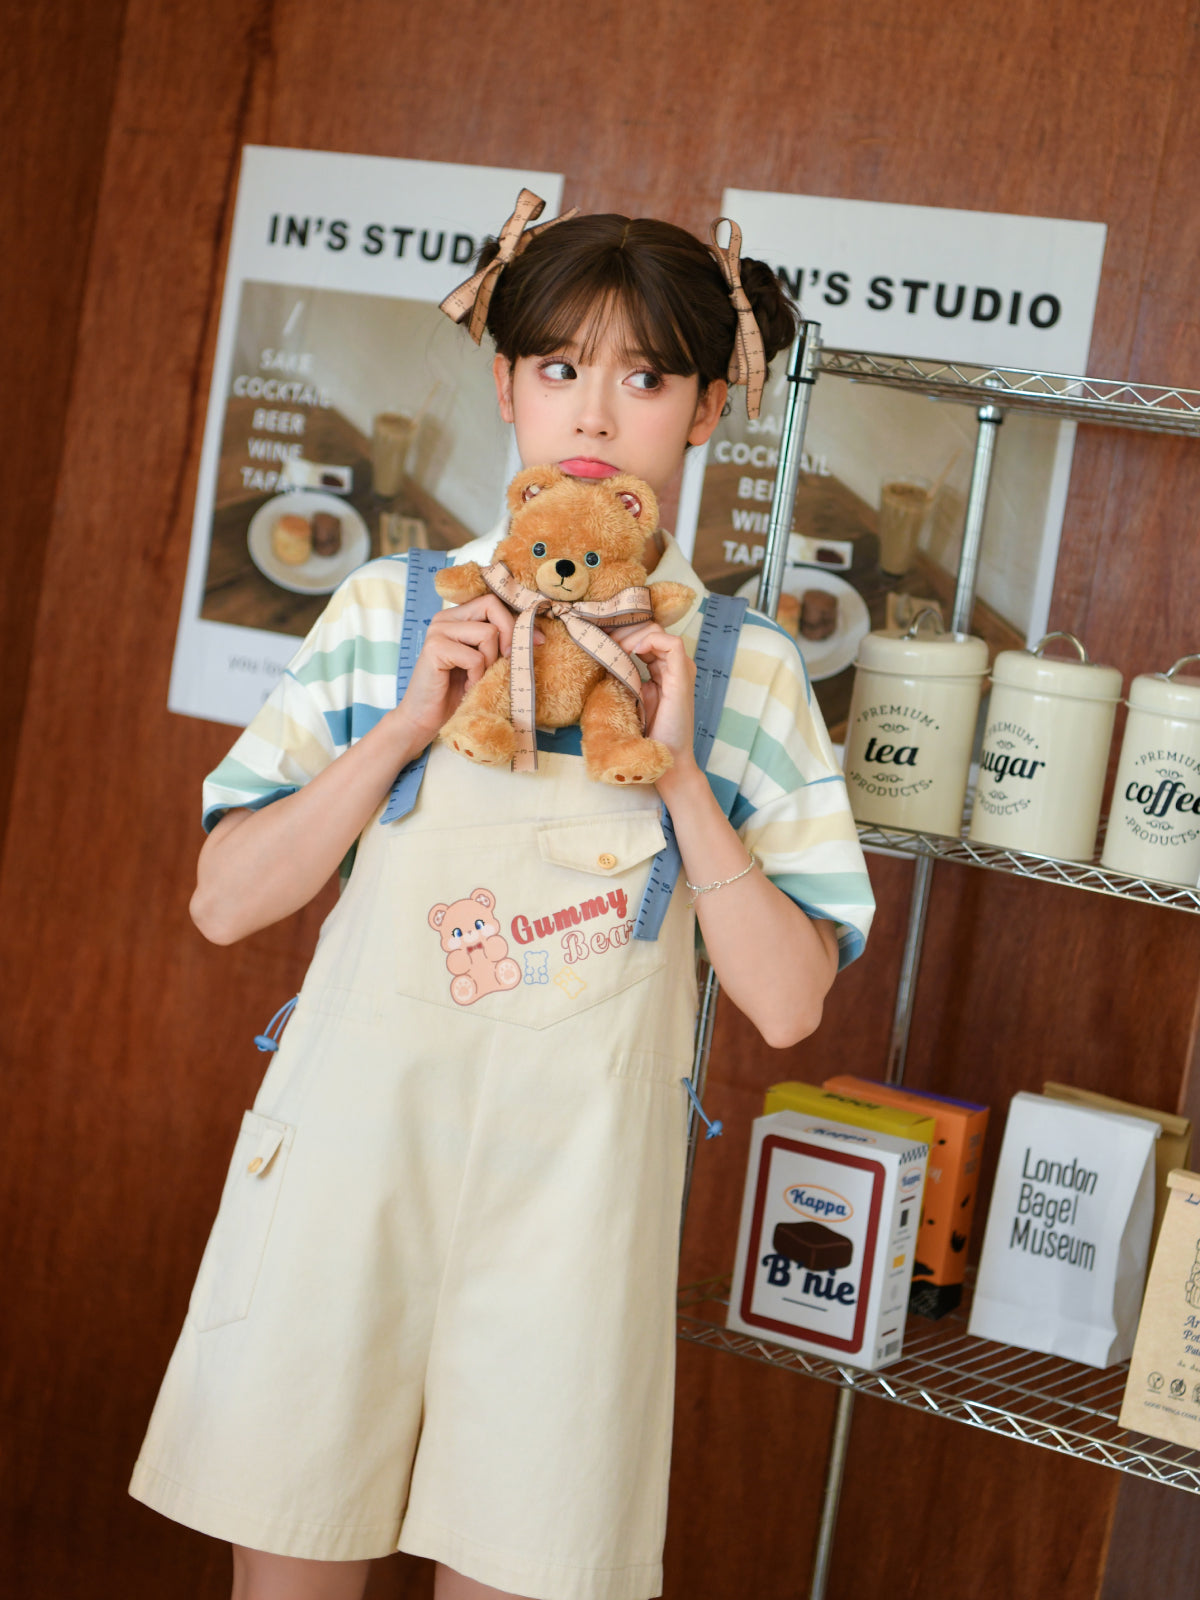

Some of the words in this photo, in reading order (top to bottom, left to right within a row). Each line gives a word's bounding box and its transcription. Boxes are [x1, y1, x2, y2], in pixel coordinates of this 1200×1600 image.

[267, 213, 350, 251] IN'S
[363, 223, 476, 265] STUD
[776, 264, 851, 306] N'S
[866, 275, 1062, 330] STUDIO
[233, 374, 333, 409] COCKTAIL
[252, 407, 307, 437] BEER
[247, 437, 304, 464] WINE
[428, 565, 438, 573] 5
[712, 668, 723, 679] 12
[861, 704, 936, 728] PREMIUM
[864, 736, 920, 768] tea
[852, 772, 931, 799] PRODUCTS
[1127, 817, 1198, 847] PRODUCTS
[660, 882, 671, 893] 16
[510, 887, 629, 946] Gummy
[1022, 1146, 1099, 1196] London
[790, 1187, 847, 1216] Kappa
[1018, 1182, 1080, 1229] Bagel
[1009, 1216, 1097, 1272] Museum
